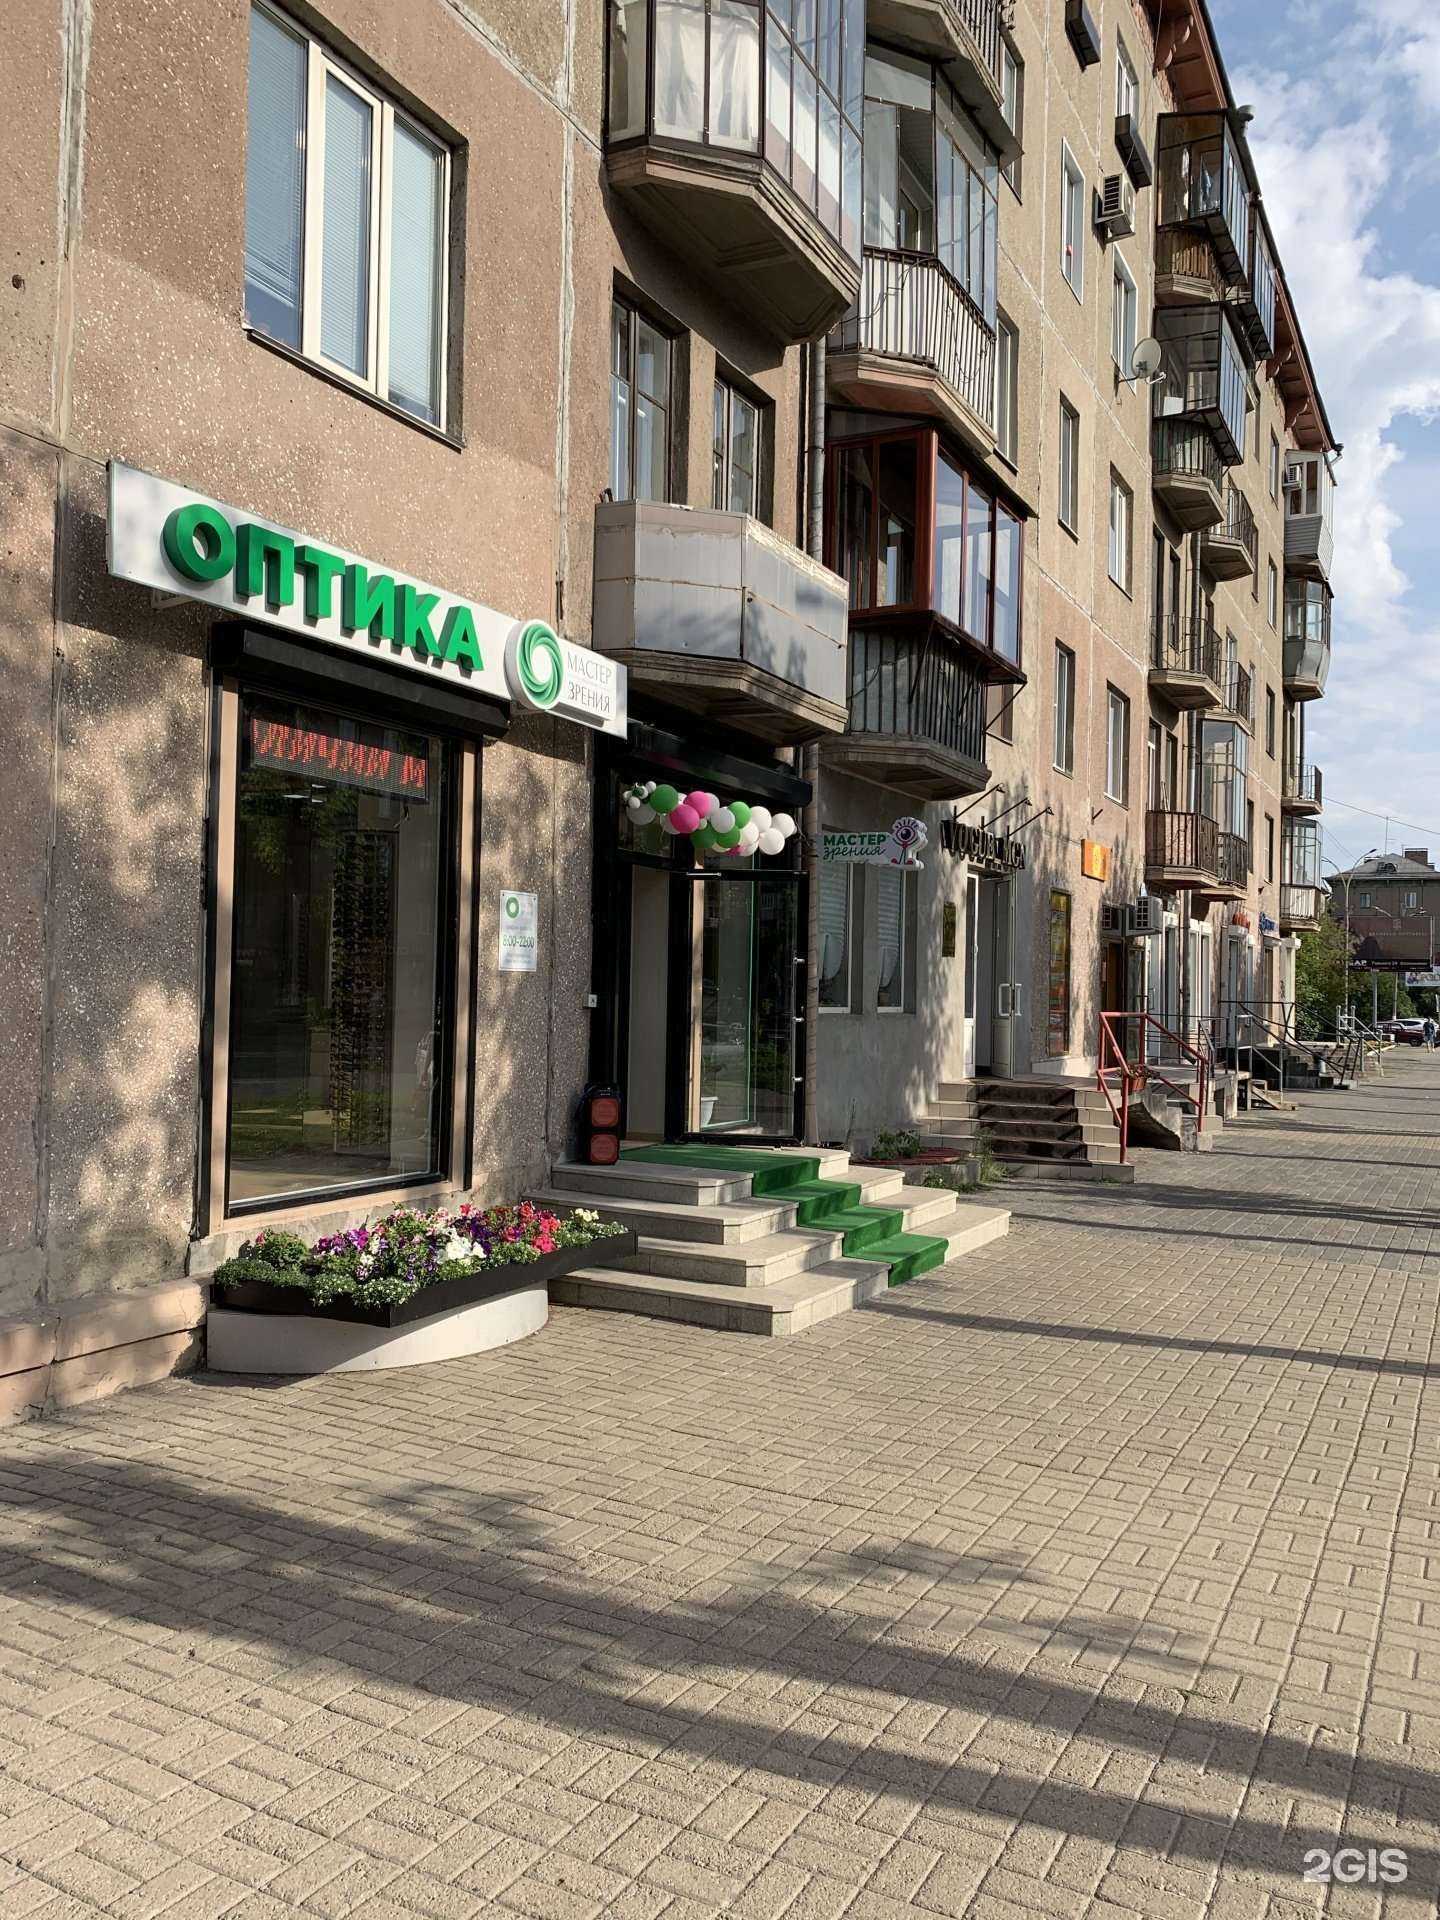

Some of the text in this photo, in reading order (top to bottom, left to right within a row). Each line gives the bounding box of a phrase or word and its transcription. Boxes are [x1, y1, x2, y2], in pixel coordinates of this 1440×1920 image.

[163, 503, 485, 672] ОПТИКА
[567, 650, 613, 685] МАСТЕР
[567, 680, 611, 714] ЗРЕНИЯ
[822, 833, 887, 846] МАСТЕР
[823, 846, 887, 861] зрения
